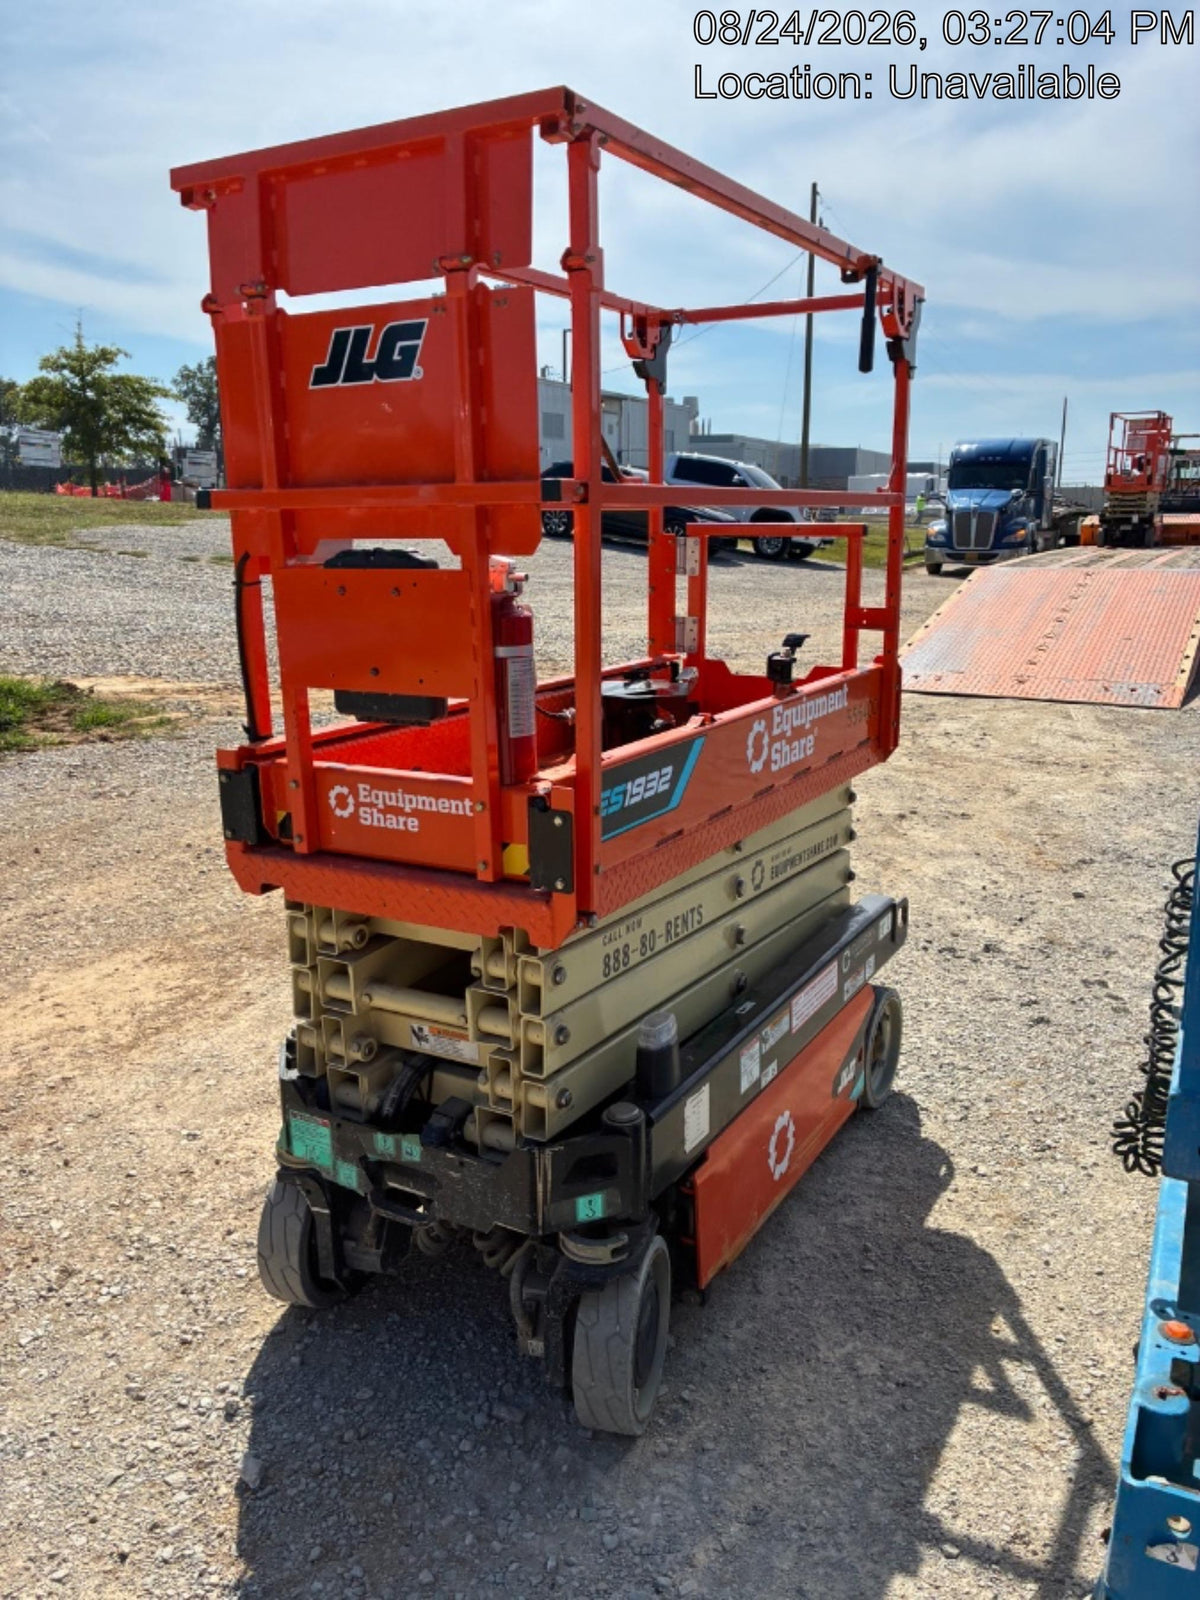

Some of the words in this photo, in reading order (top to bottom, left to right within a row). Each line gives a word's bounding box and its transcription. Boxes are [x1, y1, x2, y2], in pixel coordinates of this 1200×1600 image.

[309, 318, 429, 390] JLG
[772, 683, 849, 736] Equipment
[770, 736, 815, 773] Share
[357, 783, 474, 817] Equipment
[601, 765, 673, 817] ES1932
[358, 806, 420, 832] Share
[602, 903, 704, 979] 888-80-RENTS
